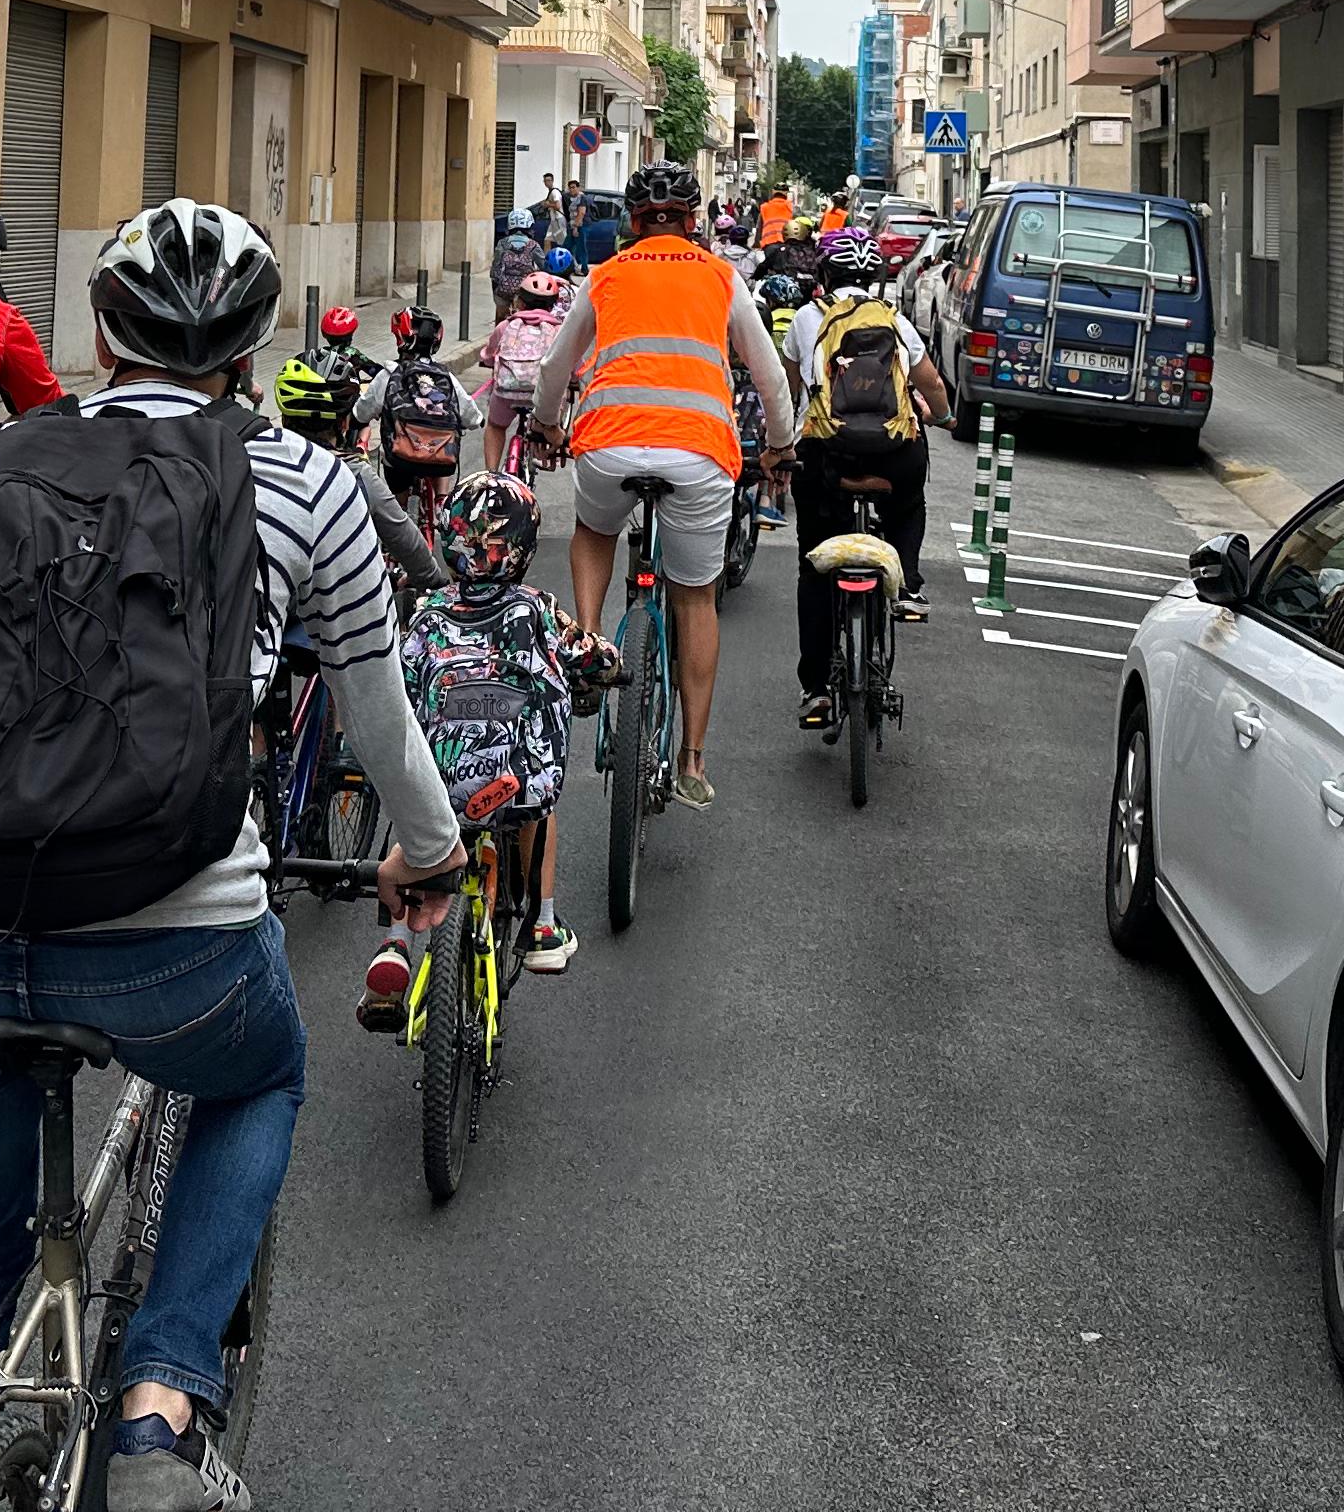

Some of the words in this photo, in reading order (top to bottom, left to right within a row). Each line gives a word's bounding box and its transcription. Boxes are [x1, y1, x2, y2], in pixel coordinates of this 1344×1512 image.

[617, 251, 707, 264] CONTROL
[1063, 351, 1096, 366] 7116
[1100, 355, 1126, 369] DRM
